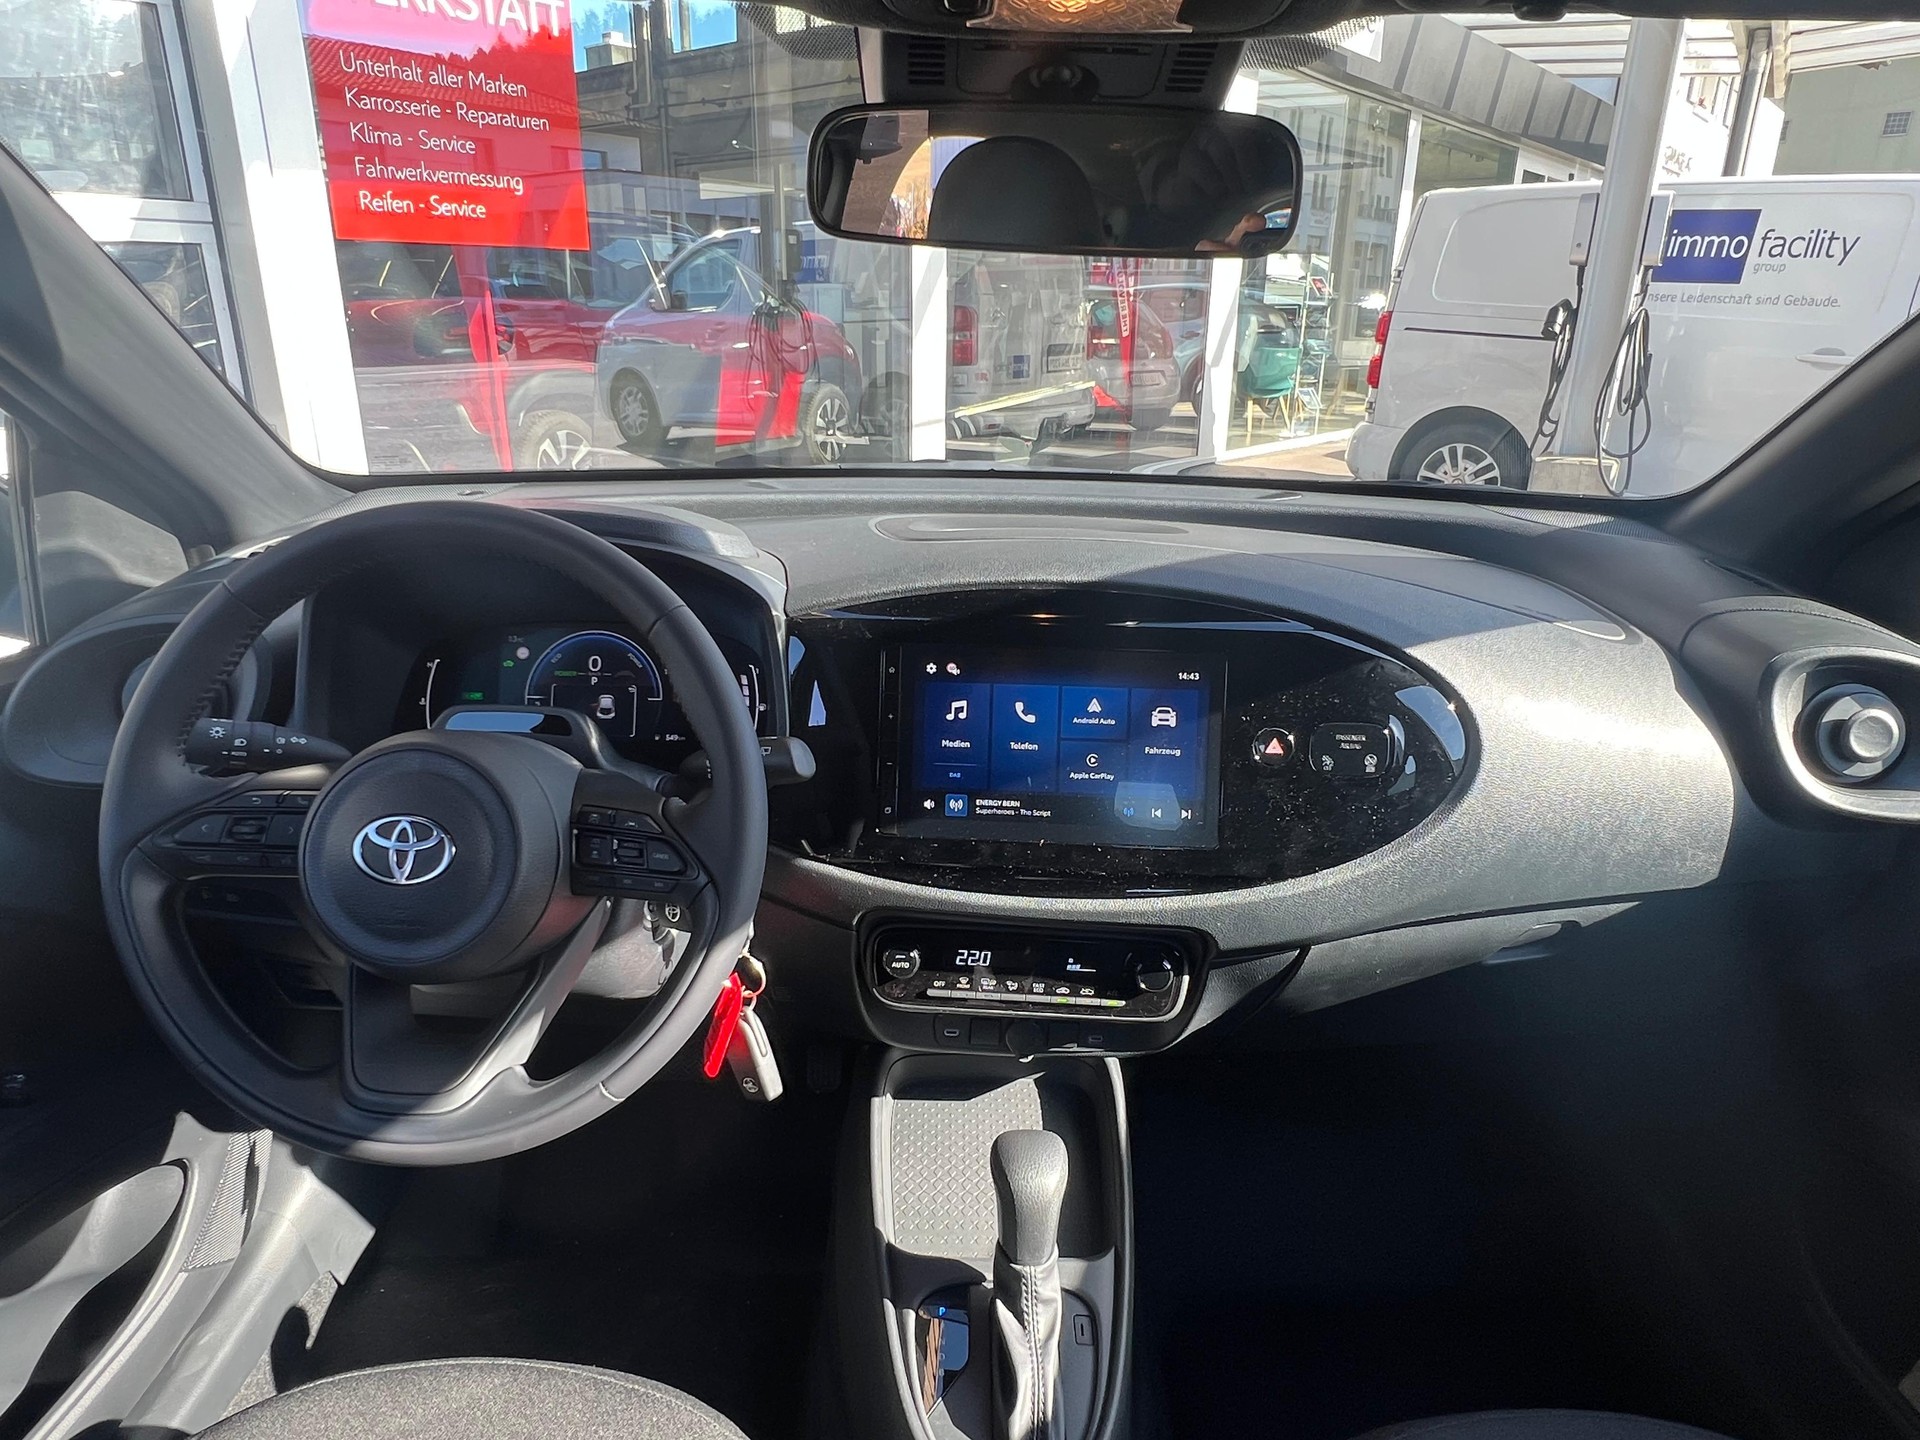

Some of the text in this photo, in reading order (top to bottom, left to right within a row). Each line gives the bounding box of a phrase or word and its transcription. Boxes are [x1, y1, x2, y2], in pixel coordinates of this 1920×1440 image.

[339, 50, 528, 98] Unterhalt aller Marken
[344, 87, 442, 118] Karrosserie
[456, 102, 550, 132] Reparaturen
[349, 122, 402, 148] Klima
[419, 130, 476, 155] Service
[354, 156, 524, 196] Fahrwerkvermessung
[359, 190, 414, 214] Reifen
[430, 194, 487, 219] Service
[1666, 228, 1861, 266] immo facility
[1752, 261, 1786, 274] group
[1647, 292, 1677, 302] nsere
[1680, 292, 1752, 305] Leidenschaft
[1755, 294, 1780, 306] sind
[588, 656, 602, 672] 0
[590, 677, 598, 686] P
[1178, 672, 1200, 681] 14:43
[941, 739, 970, 749] Medien
[1010, 742, 1038, 751] Telefon
[1144, 746, 1181, 757] Fahrzeug
[1090, 772, 1114, 781] CarPlay
[976, 799, 1002, 807] ENERGY
[975, 807, 1015, 816] Superheroes
[939, 1306, 946, 1316] P
